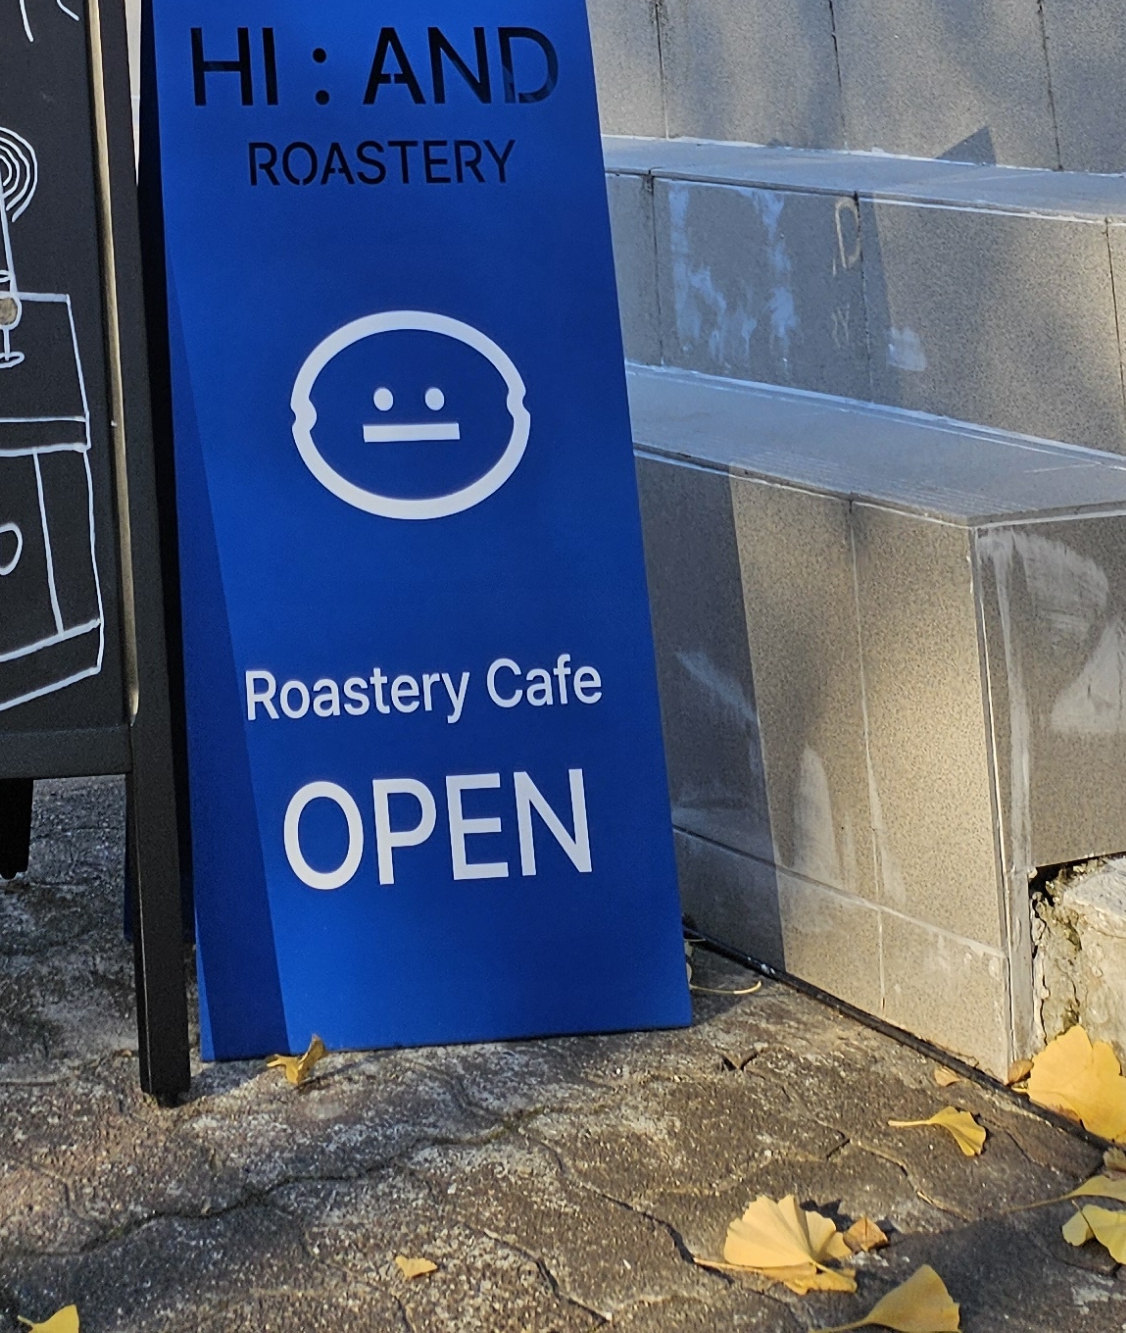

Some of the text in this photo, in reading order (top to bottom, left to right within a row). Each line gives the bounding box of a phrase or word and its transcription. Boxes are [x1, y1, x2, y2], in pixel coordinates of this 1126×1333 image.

[249, 139, 515, 187] ROASTERY
[246, 655, 604, 724] Roastery Cafe
[283, 767, 592, 891] OPEN
